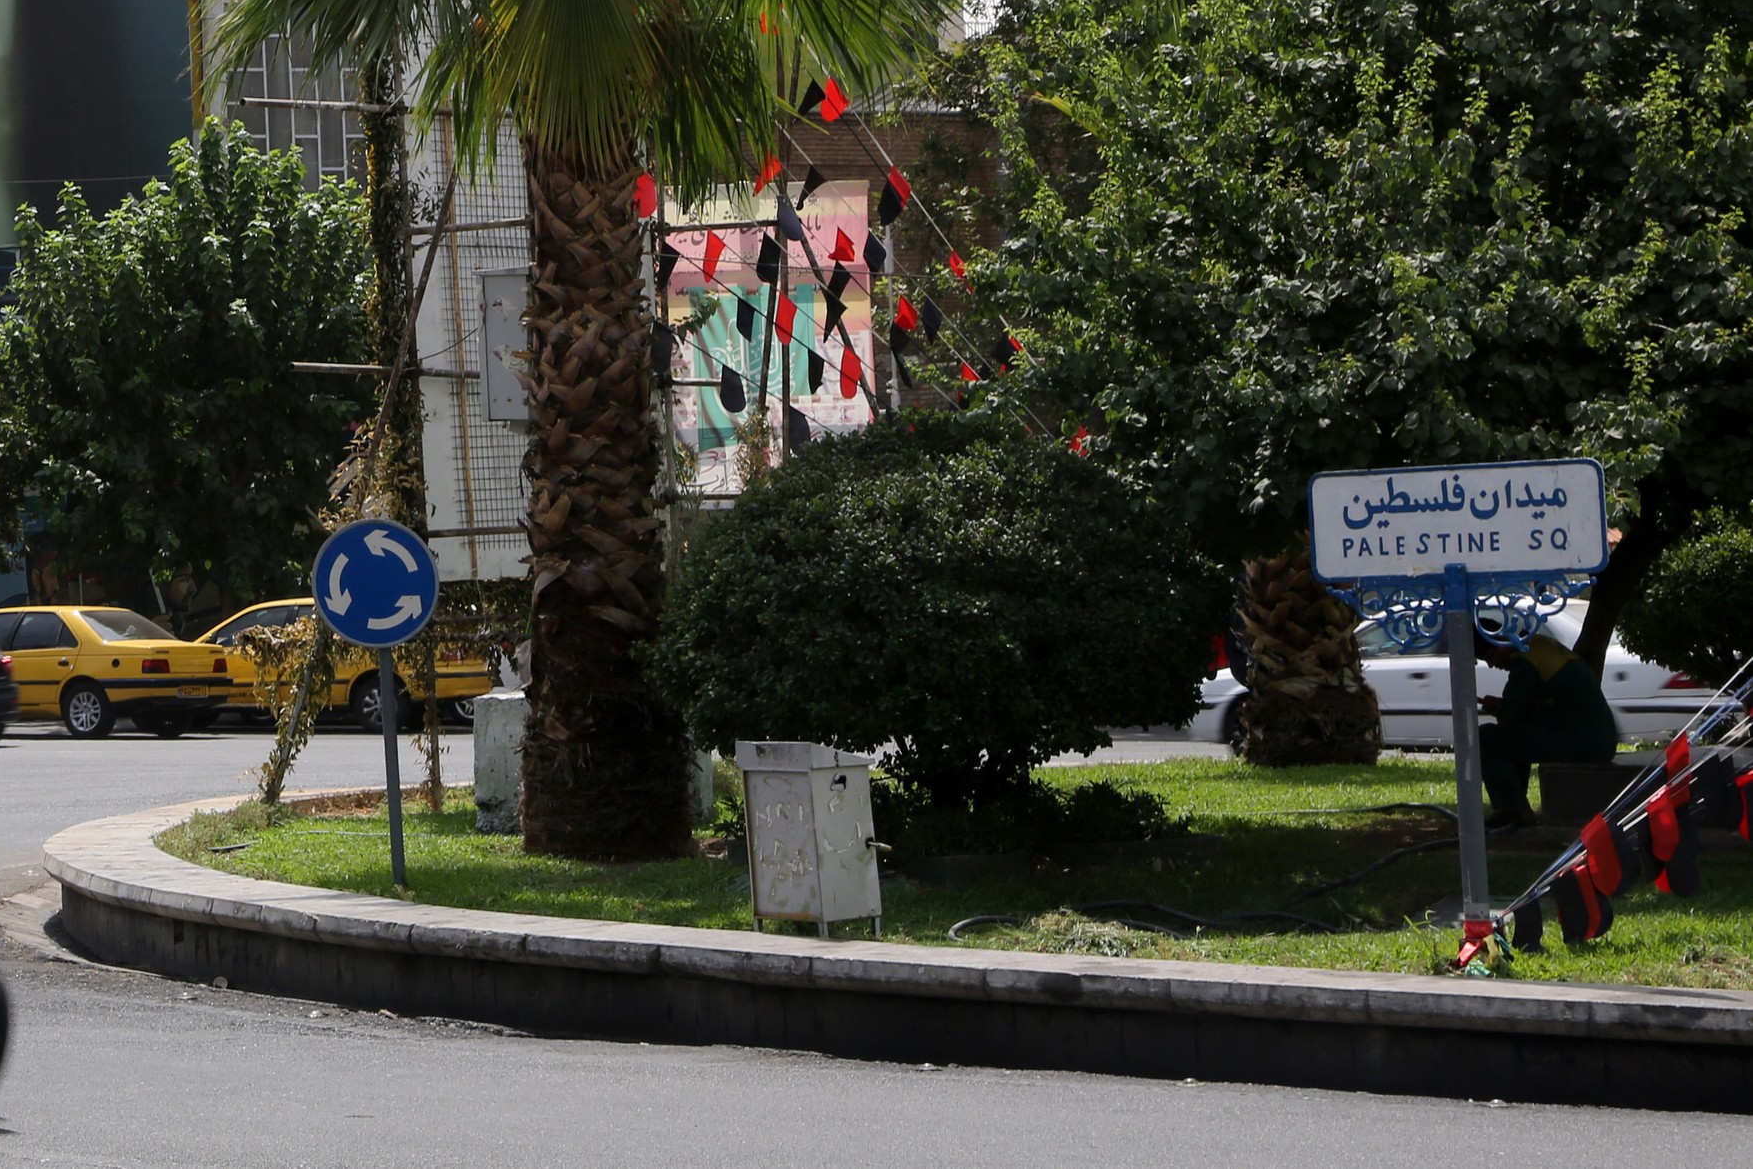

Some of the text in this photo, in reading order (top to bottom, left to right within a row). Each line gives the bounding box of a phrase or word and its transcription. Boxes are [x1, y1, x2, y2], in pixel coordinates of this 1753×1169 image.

[1342, 474, 1568, 530] میدان فلسطین
[1342, 528, 1569, 558] PALESTINE SQ
